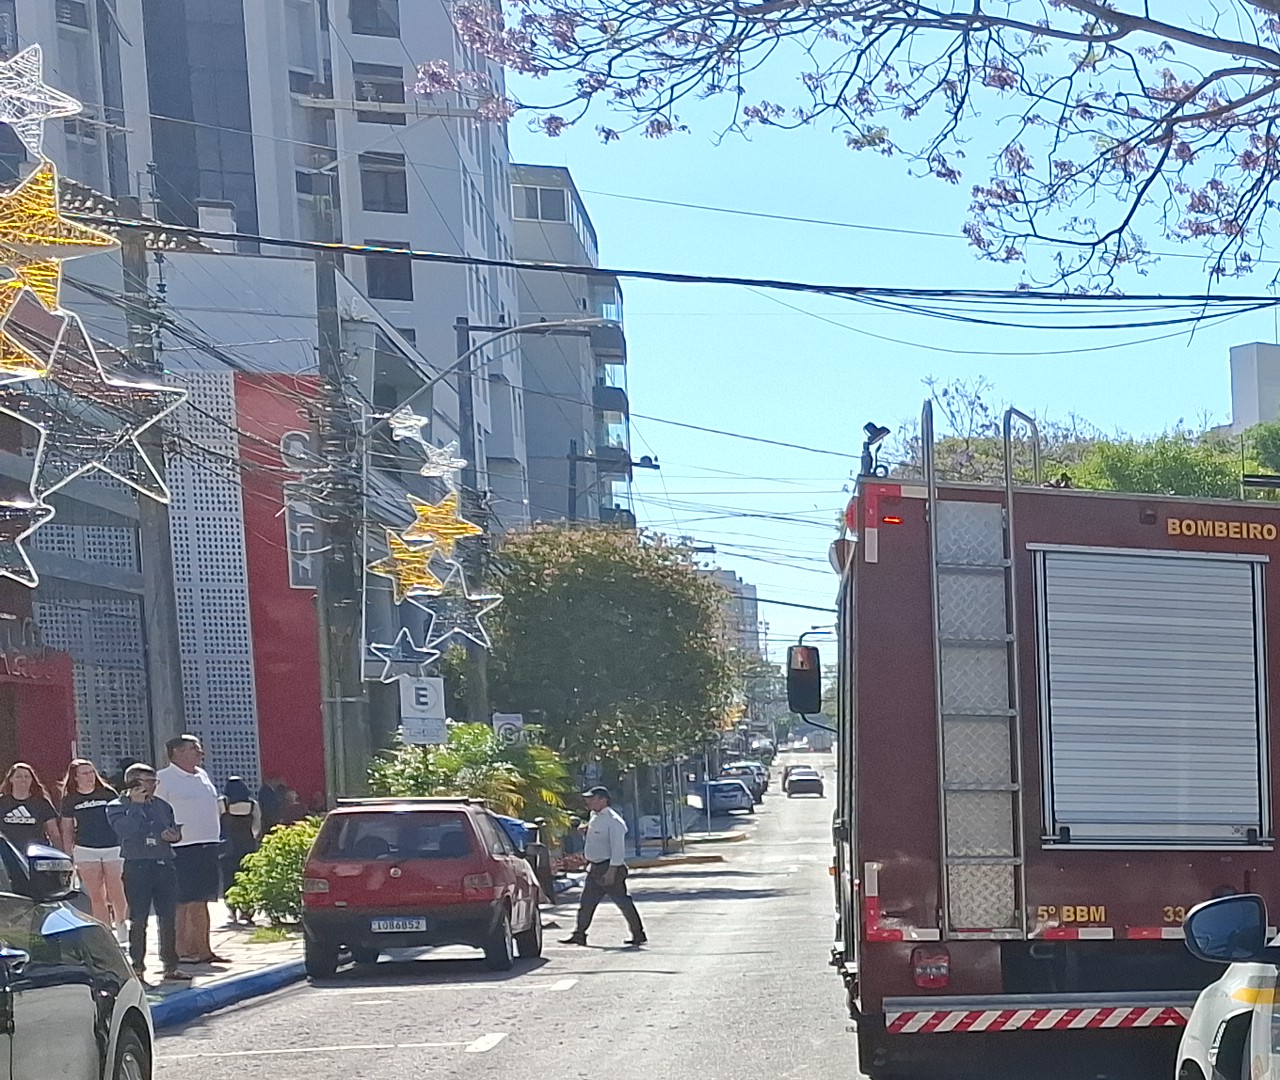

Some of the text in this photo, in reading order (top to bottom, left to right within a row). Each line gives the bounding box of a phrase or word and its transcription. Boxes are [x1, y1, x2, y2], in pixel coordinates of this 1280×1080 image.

[1167, 518, 1277, 541] BOMBEIRO
[414, 687, 428, 706] E
[1062, 906, 1106, 923] BBM
